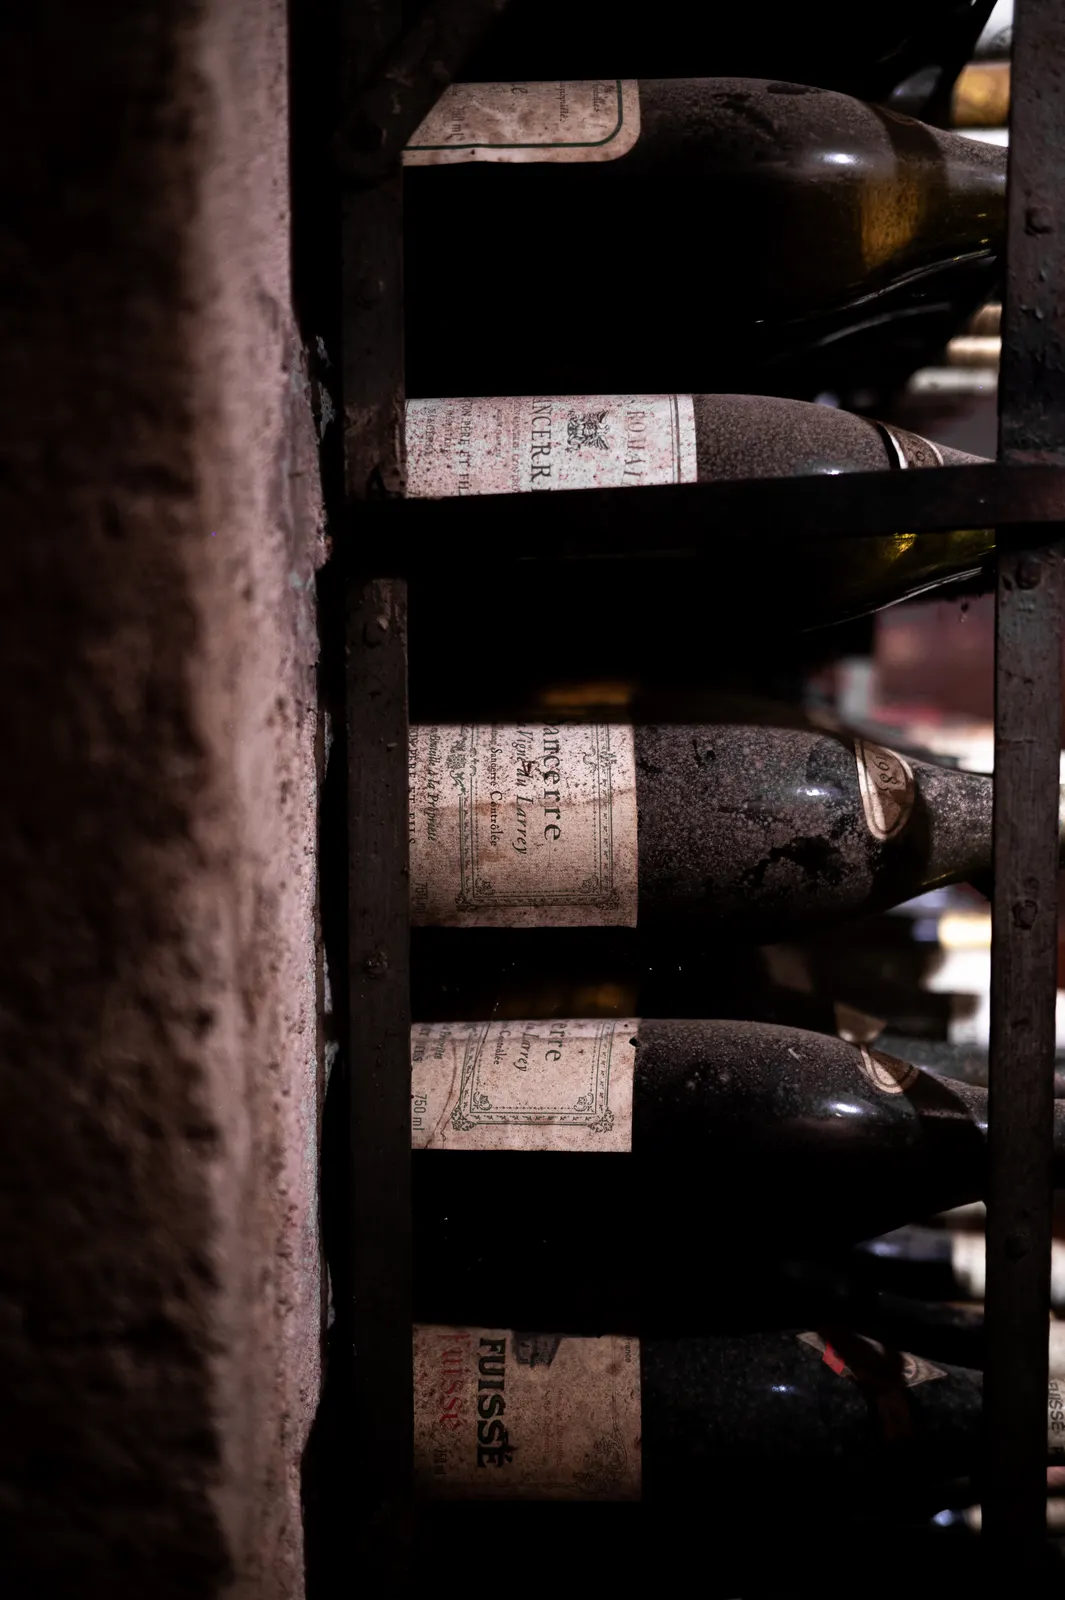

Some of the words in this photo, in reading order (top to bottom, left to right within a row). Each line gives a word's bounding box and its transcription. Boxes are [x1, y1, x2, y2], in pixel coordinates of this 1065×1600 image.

[621, 411, 647, 487] ROMAI
[490, 747, 503, 787] Sancerre
[544, 727, 563, 842] ancerre
[490, 791, 504, 847] Contrôlée
[512, 795, 534, 855] Larrey
[513, 1032, 540, 1072] Larrey
[544, 1023, 568, 1062] erre
[412, 1117, 426, 1131] ml
[413, 1094, 428, 1113] 750
[476, 1337, 513, 1468] FUISSÉ
